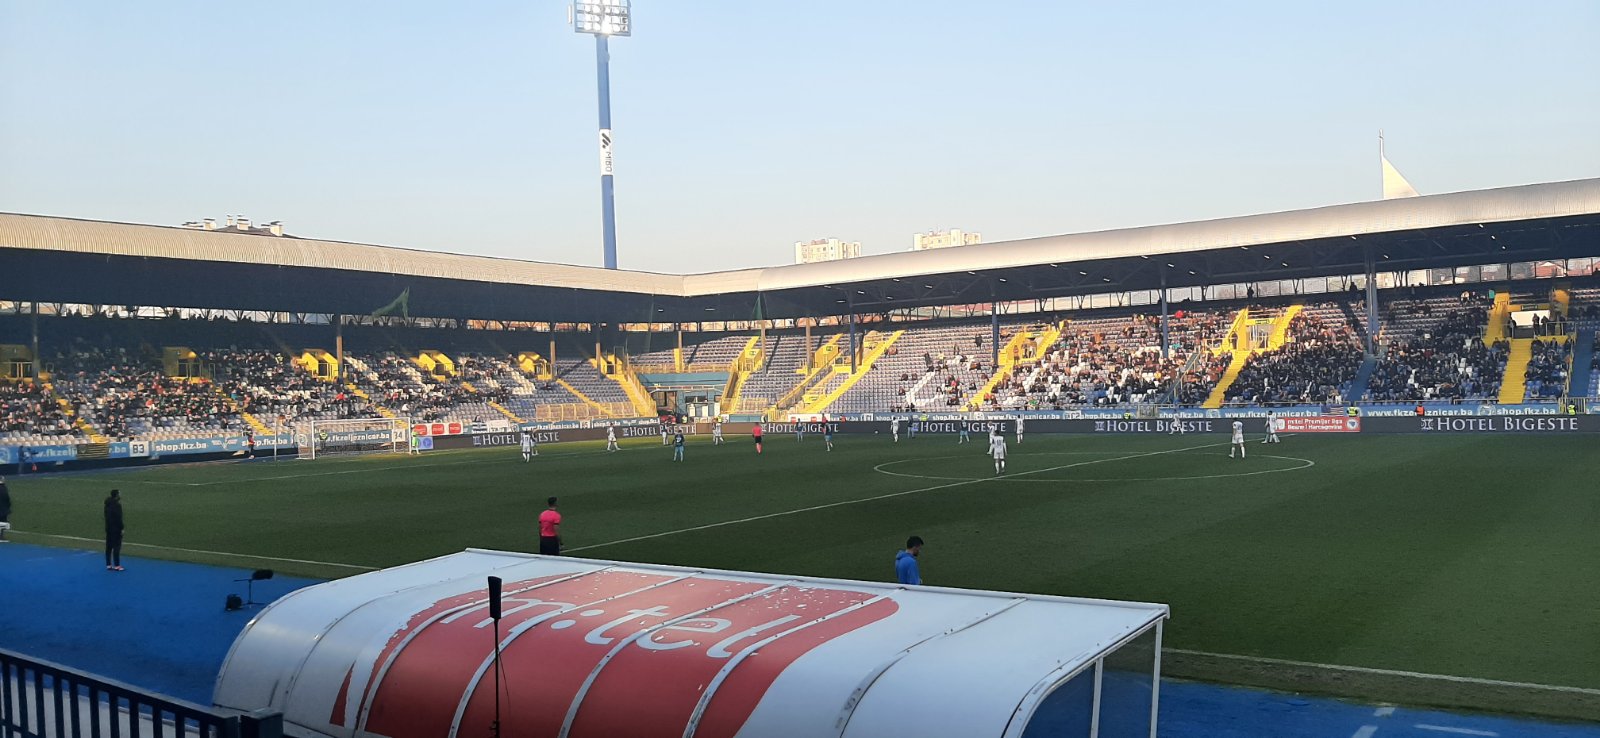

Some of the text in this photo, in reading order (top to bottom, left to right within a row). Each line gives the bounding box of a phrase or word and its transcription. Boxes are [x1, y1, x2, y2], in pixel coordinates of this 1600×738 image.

[1497, 407, 1556, 415] shop.fkz.ba
[921, 422, 956, 432] HOTEL
[1107, 420, 1151, 431] HOTEL
[1437, 417, 1578, 431] HOTEL BIGESTE
[630, 425, 658, 437] HOTEL
[483, 434, 518, 446] HOTEL
